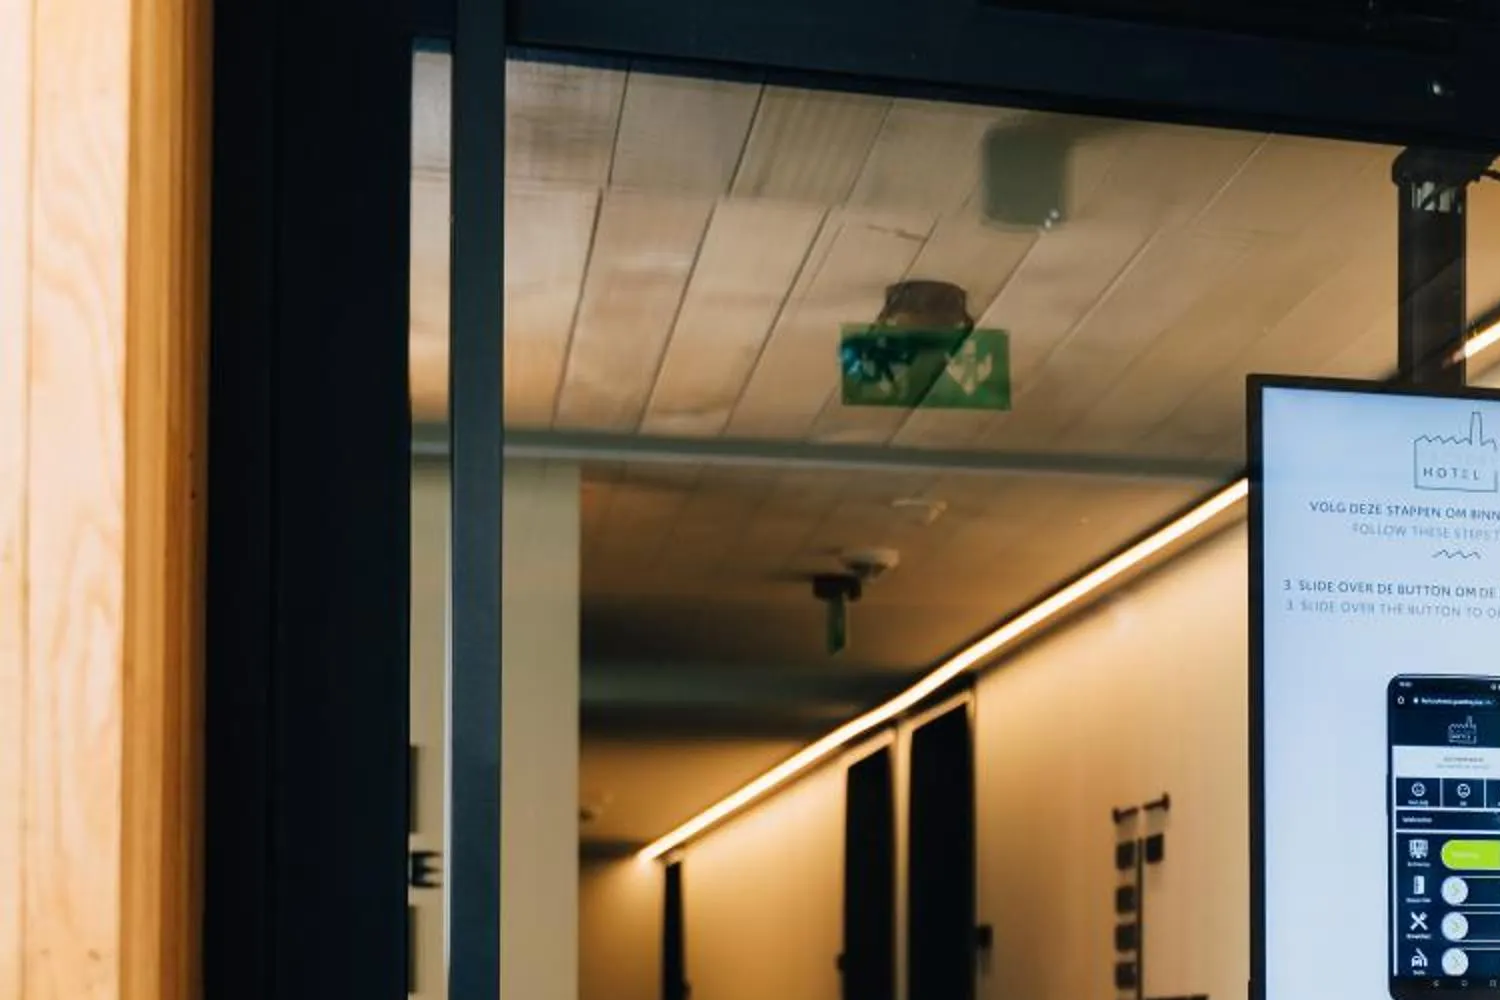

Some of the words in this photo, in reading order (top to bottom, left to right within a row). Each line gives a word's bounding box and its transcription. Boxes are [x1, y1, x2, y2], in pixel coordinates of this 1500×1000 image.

[1423, 466, 1480, 481] HOTEL
[1310, 501, 1346, 513] VOLG
[1349, 503, 1382, 515] DEZE
[1387, 504, 1441, 518] STAPPEN
[1445, 507, 1466, 519] OM
[1352, 523, 1407, 537] FOLLOW
[1412, 525, 1449, 539] THESE
[1299, 579, 1333, 592] SLIDE
[1337, 581, 1373, 594] OVER
[1377, 583, 1392, 595] DE
[1397, 584, 1450, 598] BUTTON
[1455, 587, 1477, 599] OM
[1479, 588, 1495, 600] DE
[1300, 600, 1334, 613] SLIDE
[1340, 602, 1375, 615] OVER
[1380, 603, 1403, 616] THE
[1407, 604, 1460, 618] BUTTON
[1467, 606, 1483, 619] TO
